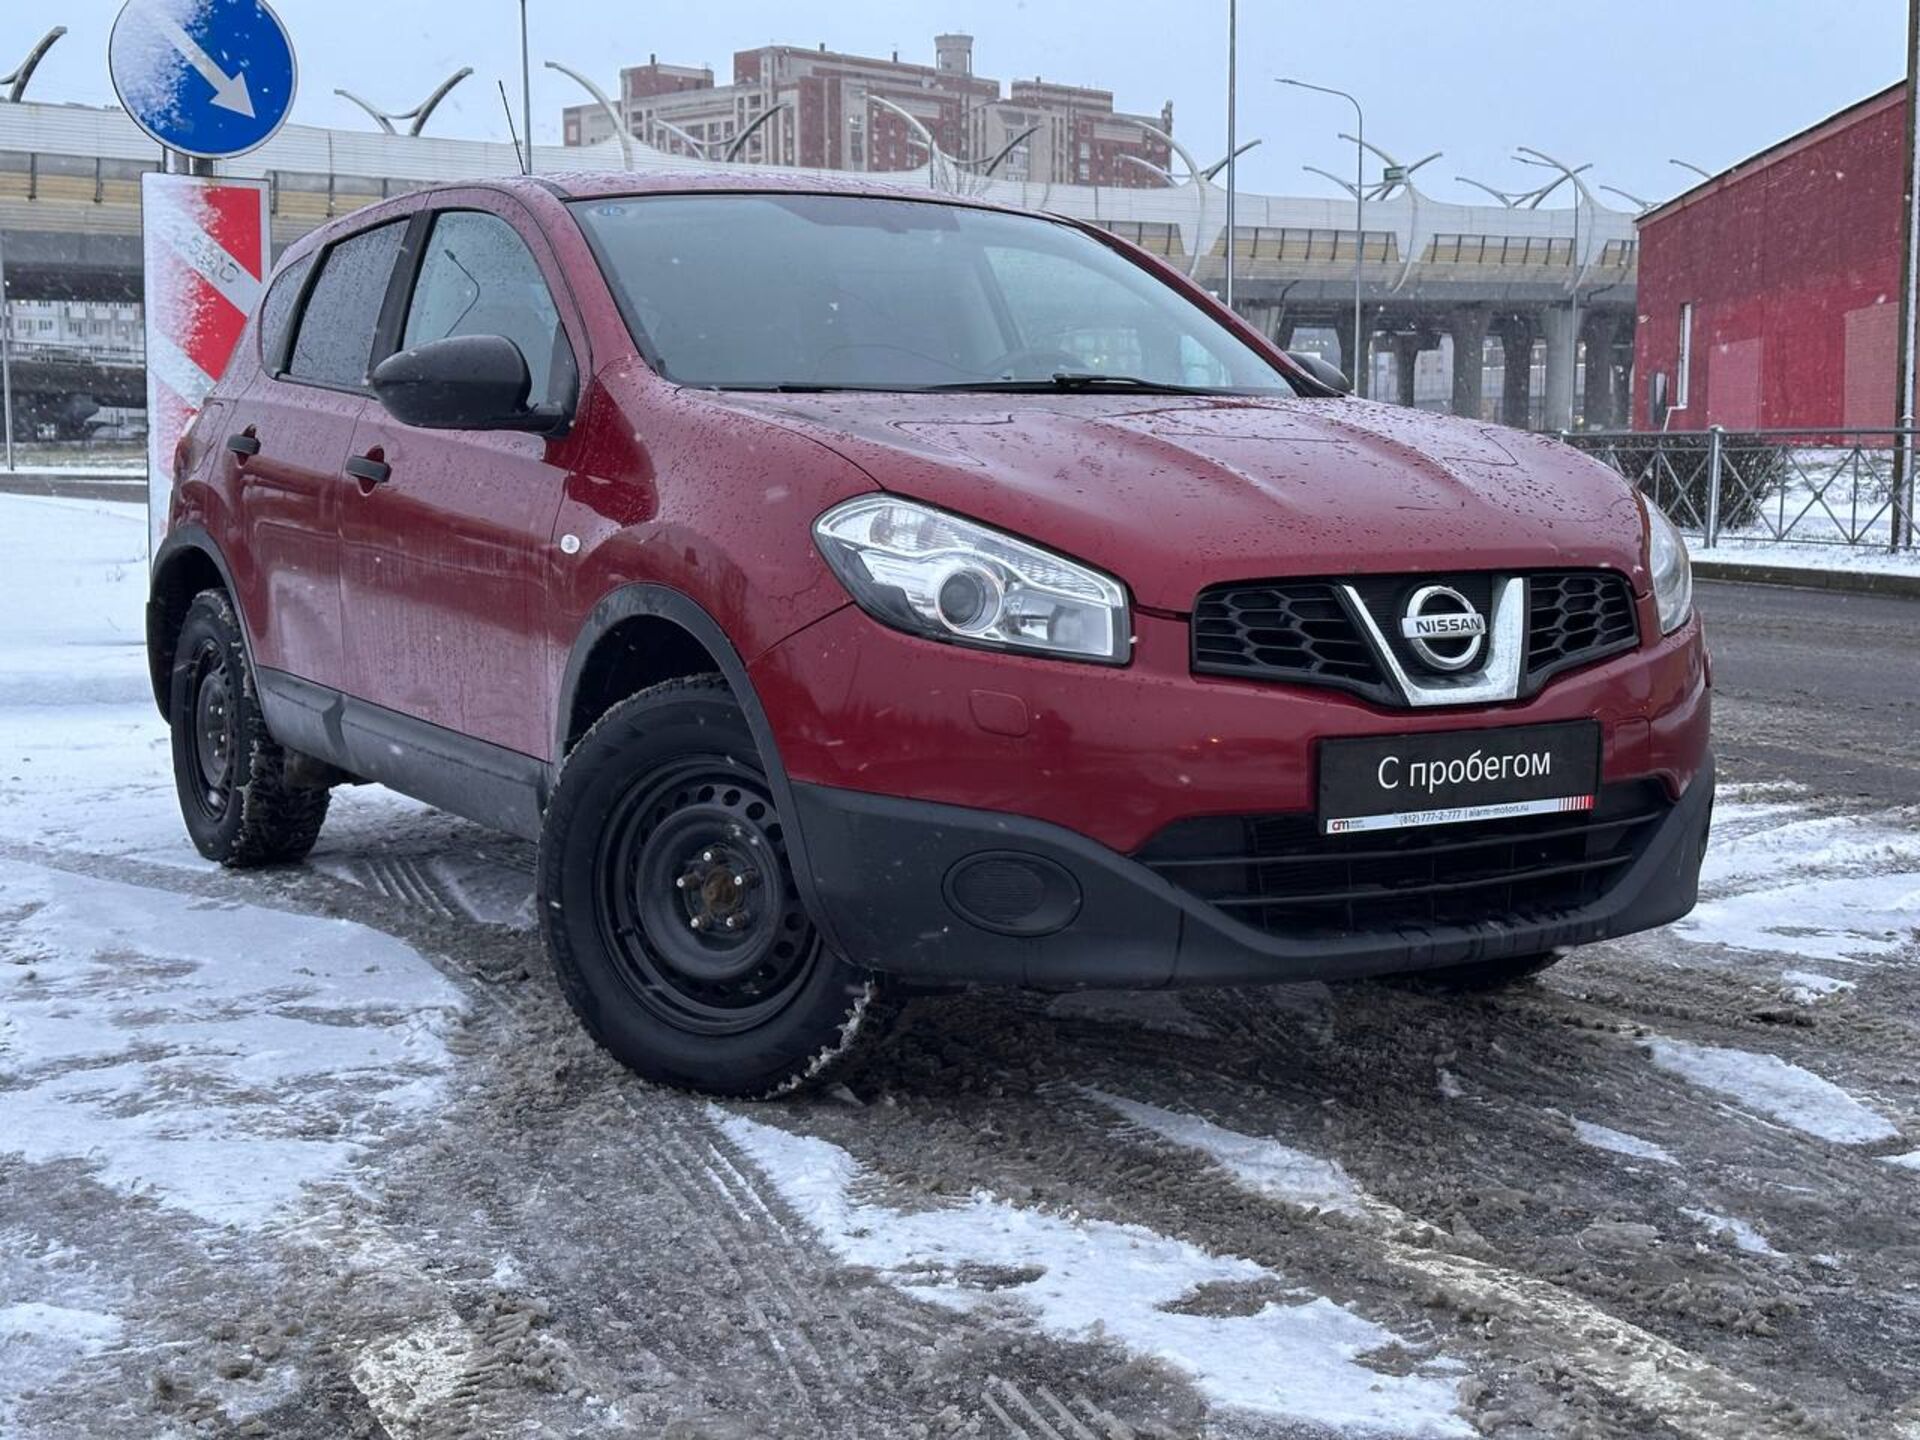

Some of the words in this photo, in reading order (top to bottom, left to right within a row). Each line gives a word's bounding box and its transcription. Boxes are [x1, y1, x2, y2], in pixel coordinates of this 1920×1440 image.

[1415, 617, 1482, 634] NISSAN
[1377, 756, 1400, 790] С
[1409, 749, 1551, 794] пробегом
[1421, 809, 1461, 822] 777-2-777
